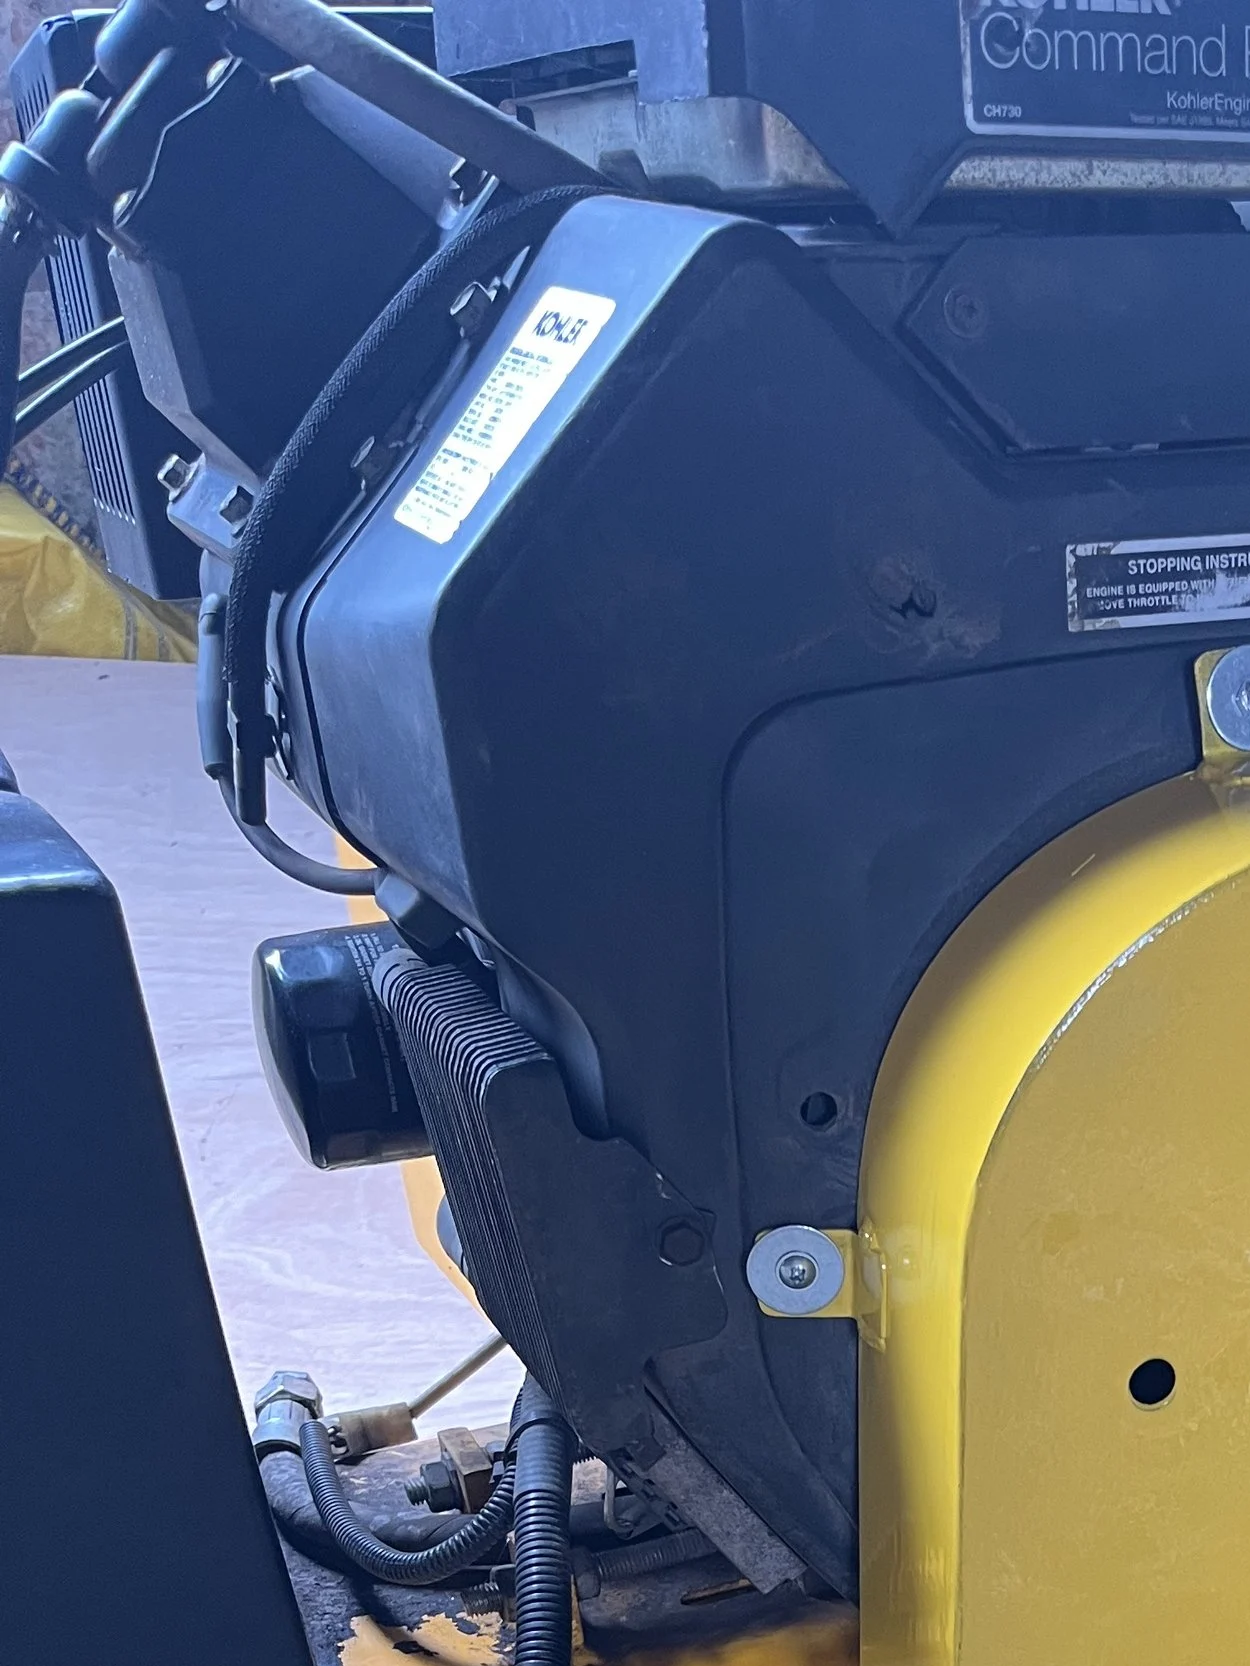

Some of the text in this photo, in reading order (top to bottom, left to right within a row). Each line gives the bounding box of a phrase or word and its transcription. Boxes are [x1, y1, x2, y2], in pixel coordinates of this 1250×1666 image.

[980, 12, 1227, 77] Command
[983, 103, 1022, 118] CH730
[1127, 555, 1202, 575] STOPPING
[1086, 585, 1124, 598] ENGINE
[1126, 584, 1137, 595] IS
[1139, 581, 1189, 594] EQUIPPED
[1190, 578, 1215, 591] WITH
[1128, 595, 1179, 608] THROTTLE
